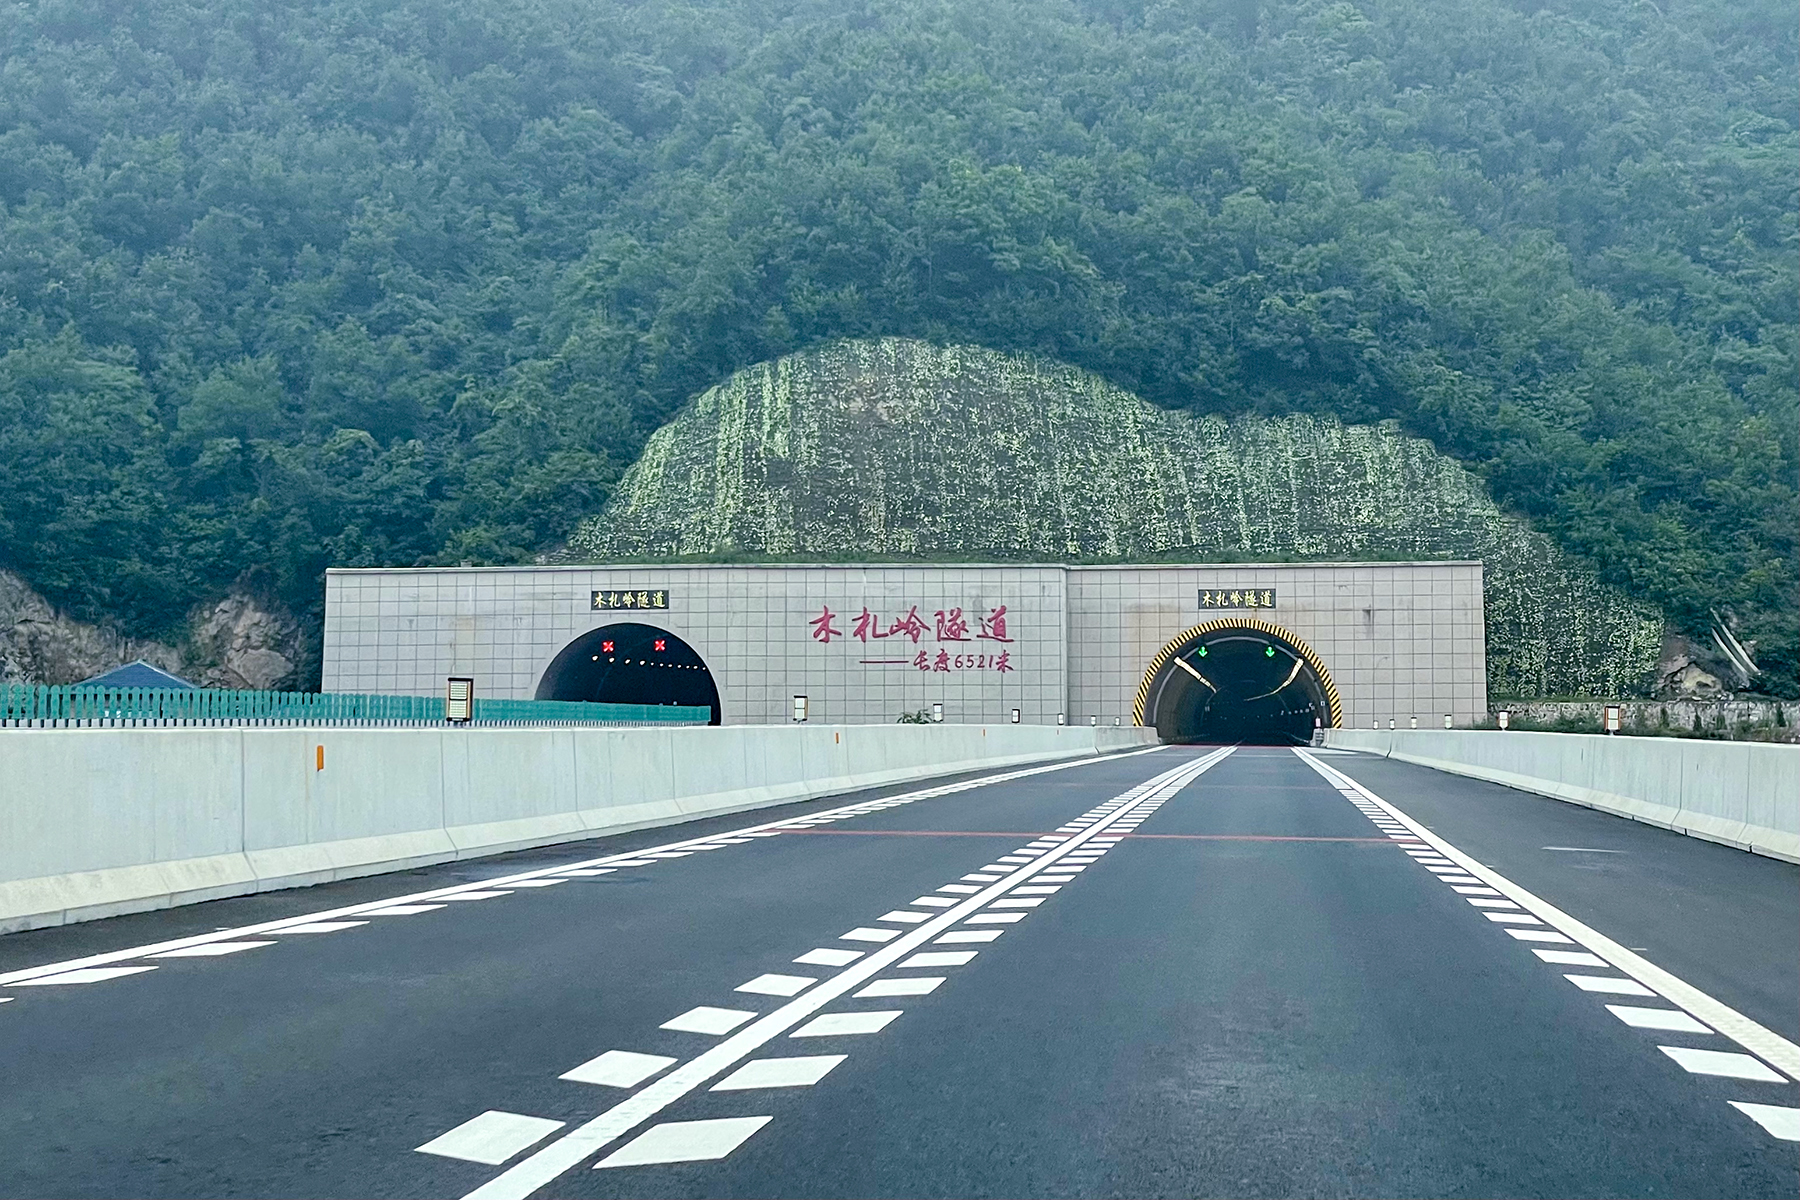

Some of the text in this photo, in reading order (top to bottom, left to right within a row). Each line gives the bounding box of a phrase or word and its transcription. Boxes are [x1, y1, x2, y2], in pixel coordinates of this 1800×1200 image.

[809, 605, 1015, 643] 木札岭隧道
